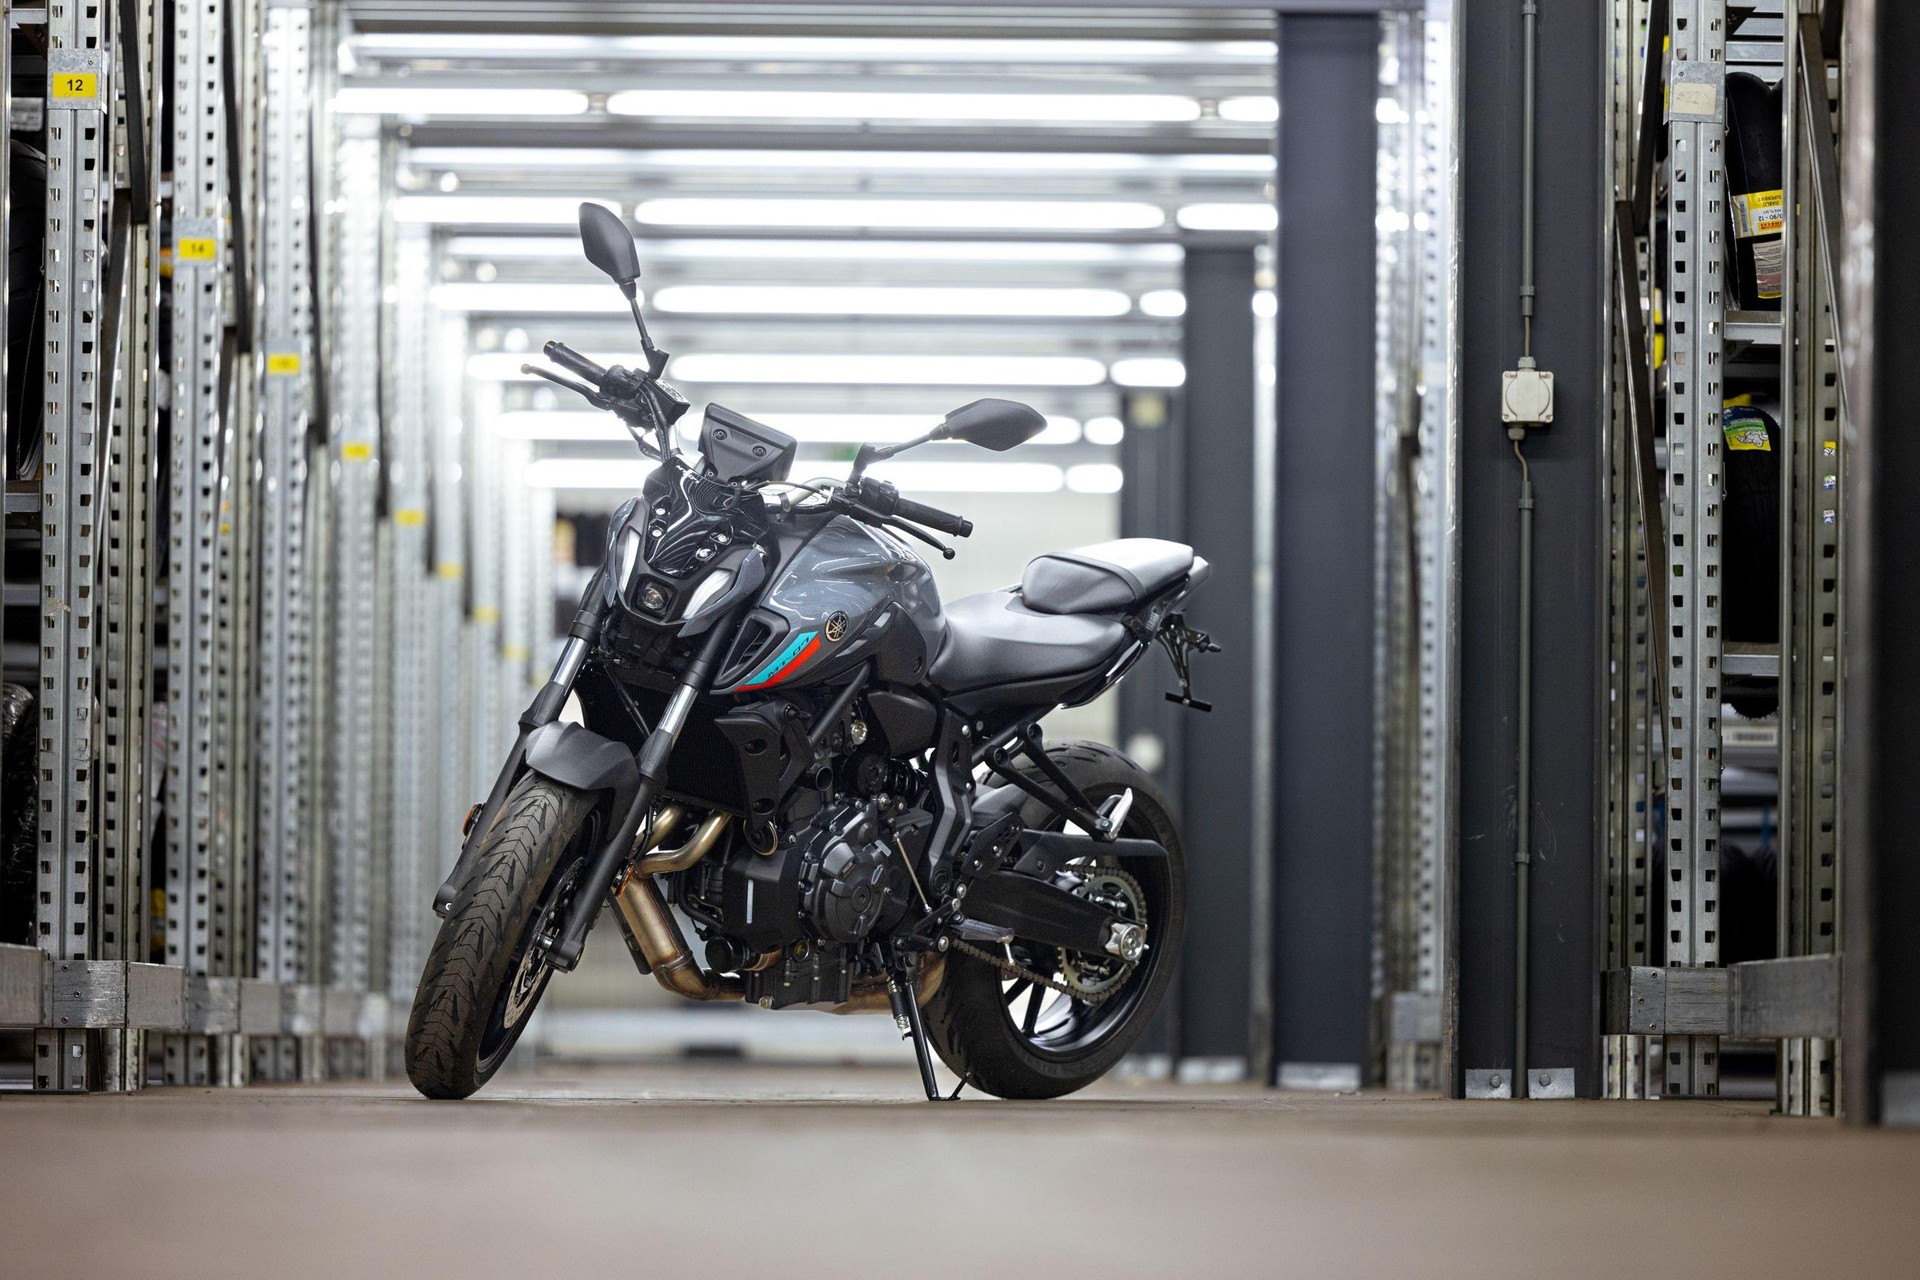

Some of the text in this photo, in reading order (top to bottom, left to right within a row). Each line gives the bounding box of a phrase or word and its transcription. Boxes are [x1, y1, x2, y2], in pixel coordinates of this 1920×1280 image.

[67, 79, 83, 91] 12
[675, 465, 700, 484] MT07
[767, 636, 810, 678] MT-07
